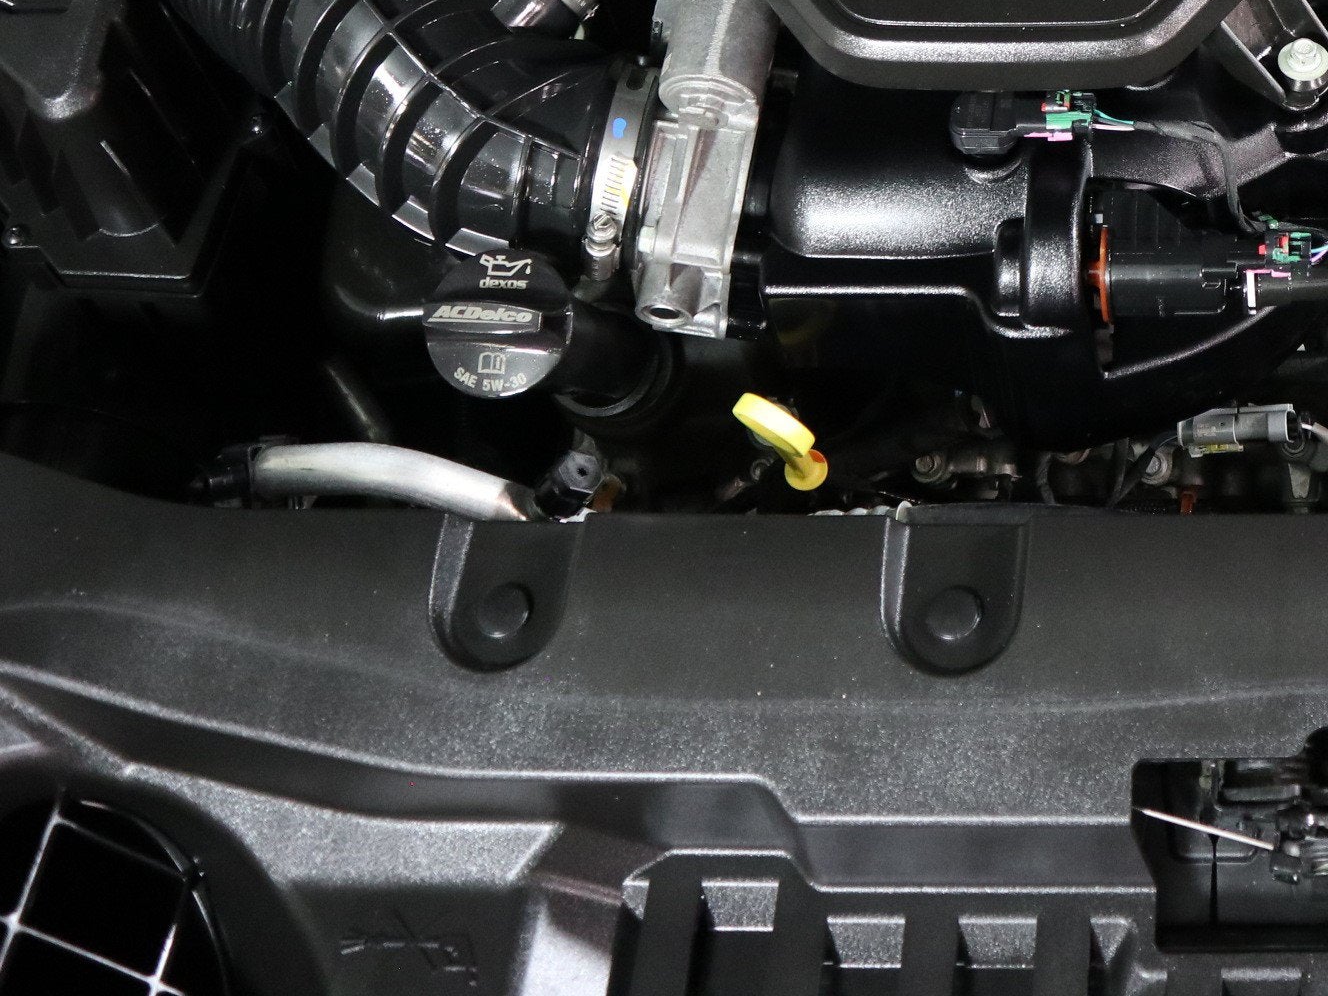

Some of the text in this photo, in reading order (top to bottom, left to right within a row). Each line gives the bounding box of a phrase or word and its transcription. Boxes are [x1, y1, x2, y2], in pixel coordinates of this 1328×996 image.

[479, 276, 530, 290] dexos
[428, 305, 533, 324] ACDelco
[453, 366, 527, 392] SAE 5W-30
